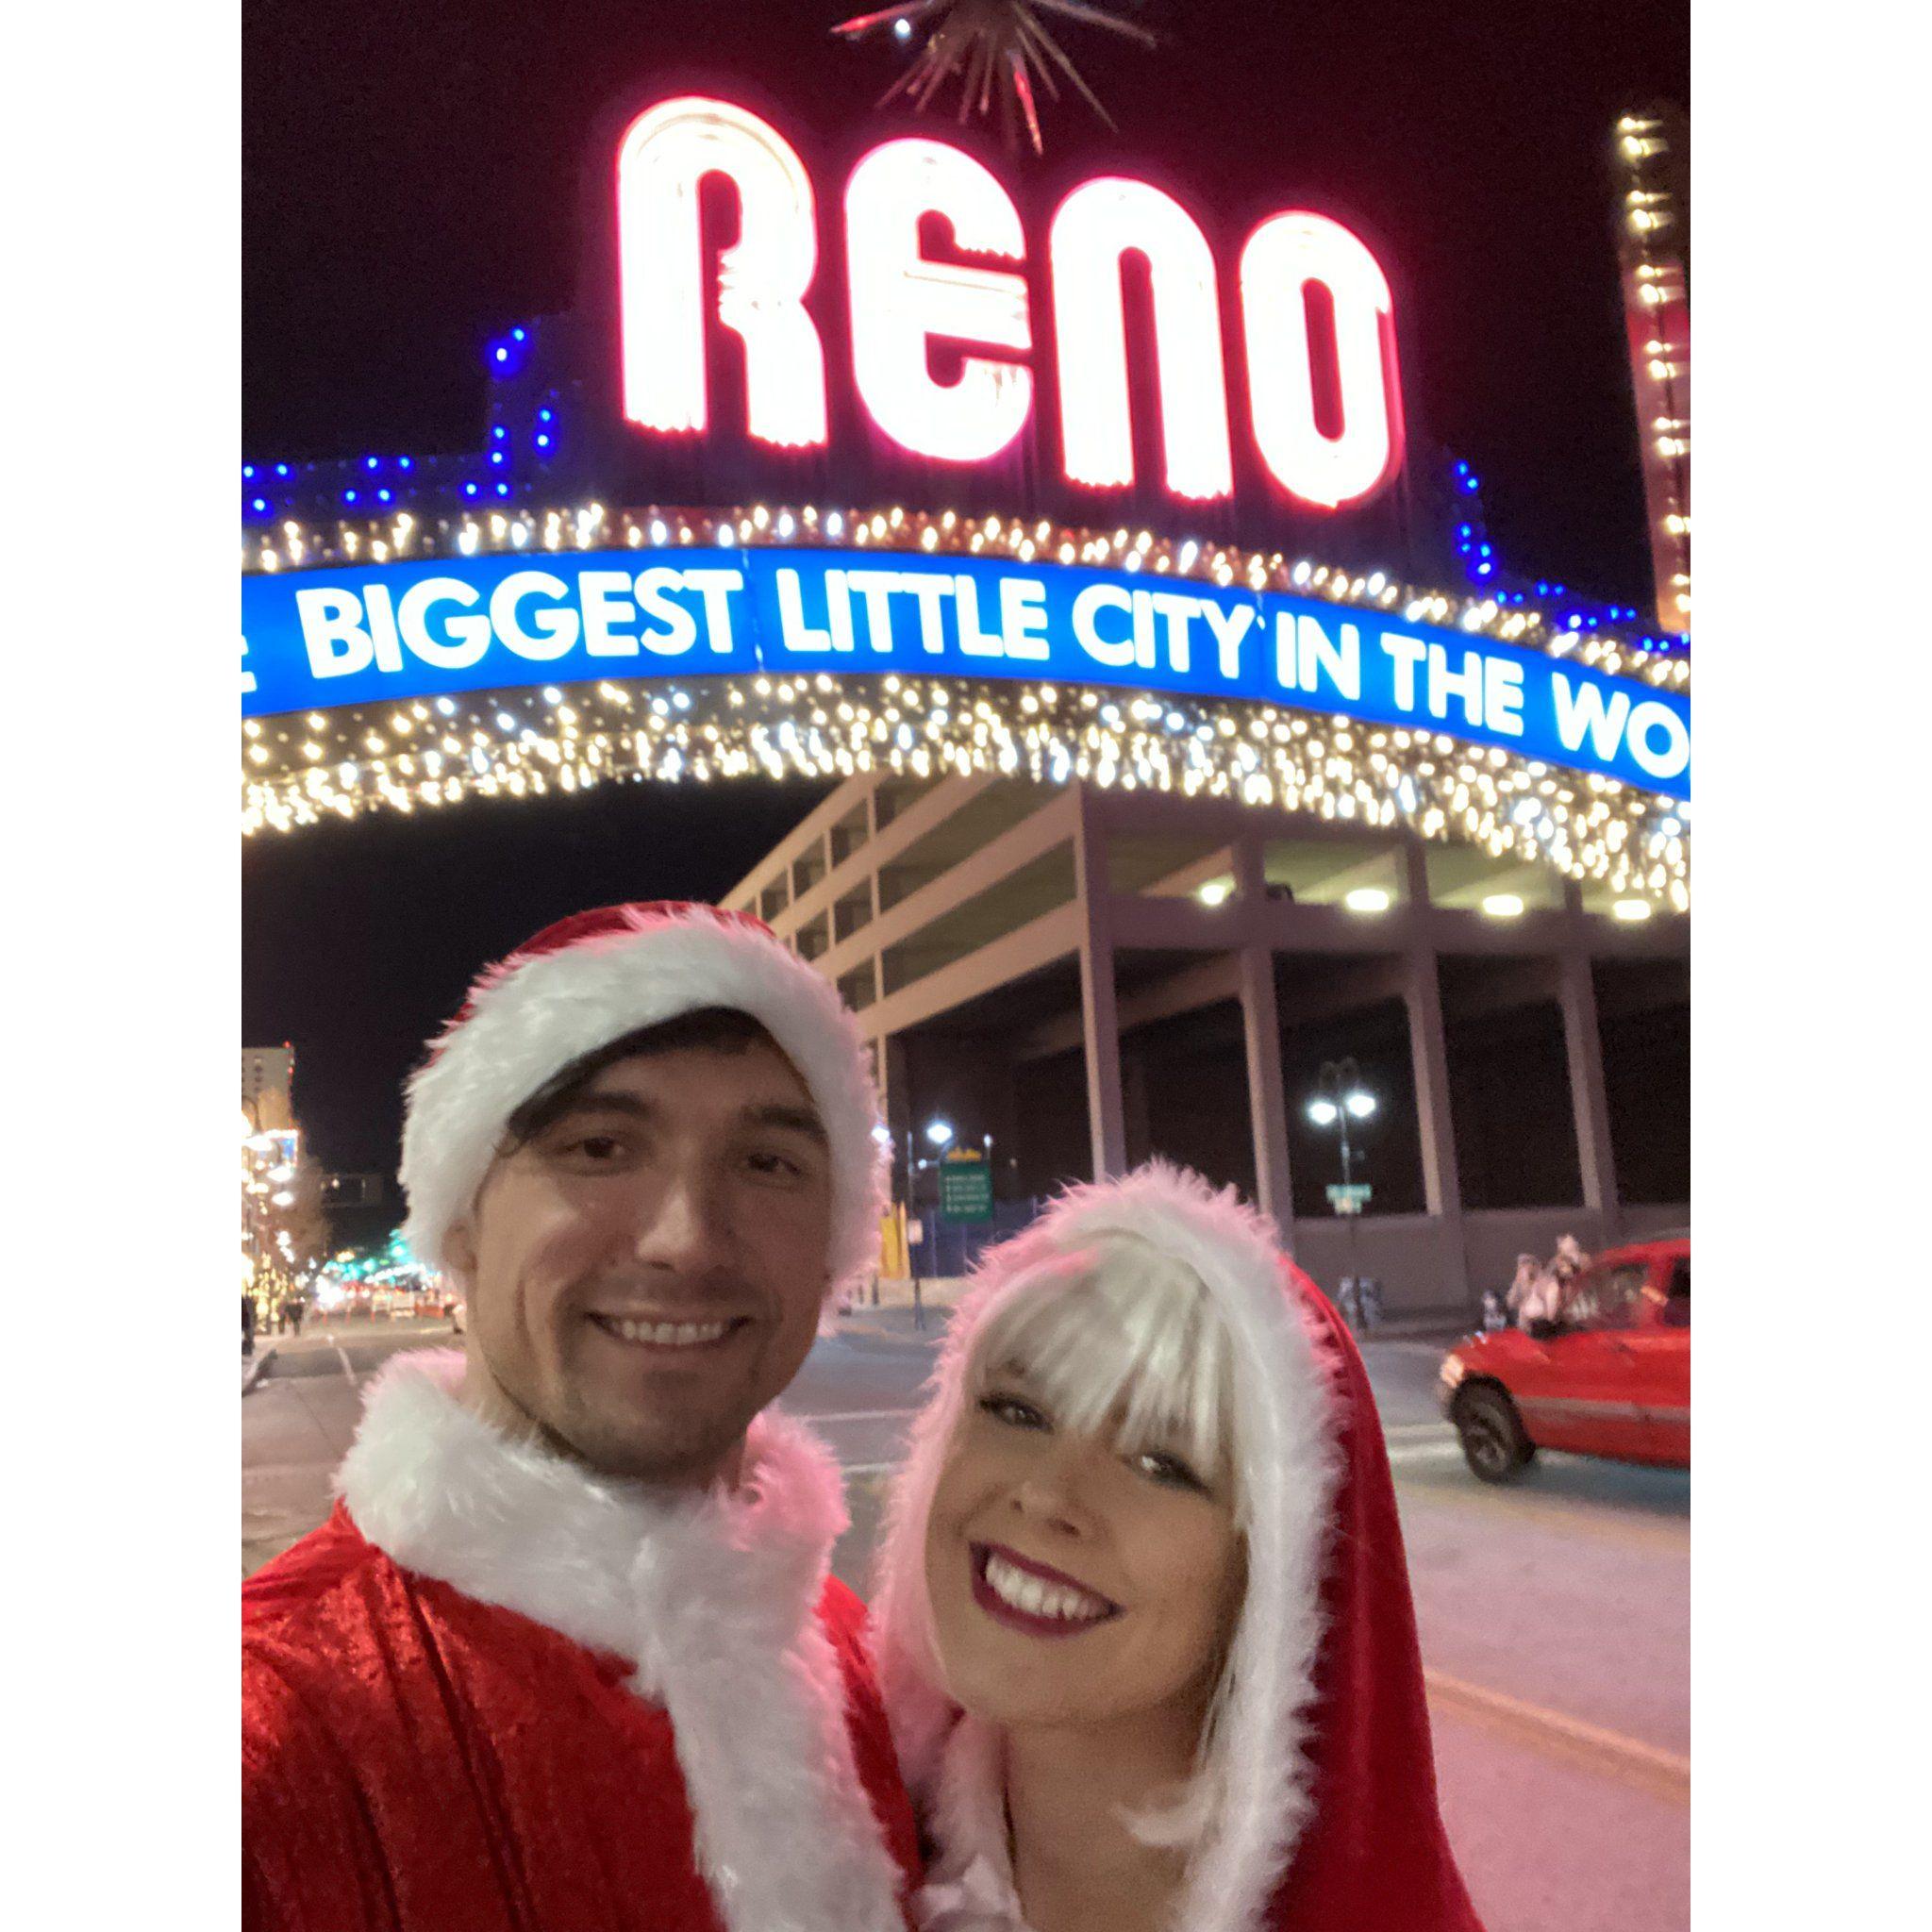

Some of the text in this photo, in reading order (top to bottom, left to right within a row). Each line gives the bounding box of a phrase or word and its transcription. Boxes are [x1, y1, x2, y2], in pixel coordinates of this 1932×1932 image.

[296, 568, 743, 678] BIGGEST
[776, 569, 1049, 660] LITTLE
[1073, 584, 1255, 678] CITY
[1276, 611, 1359, 700] IN
[1381, 633, 1524, 736] THE
